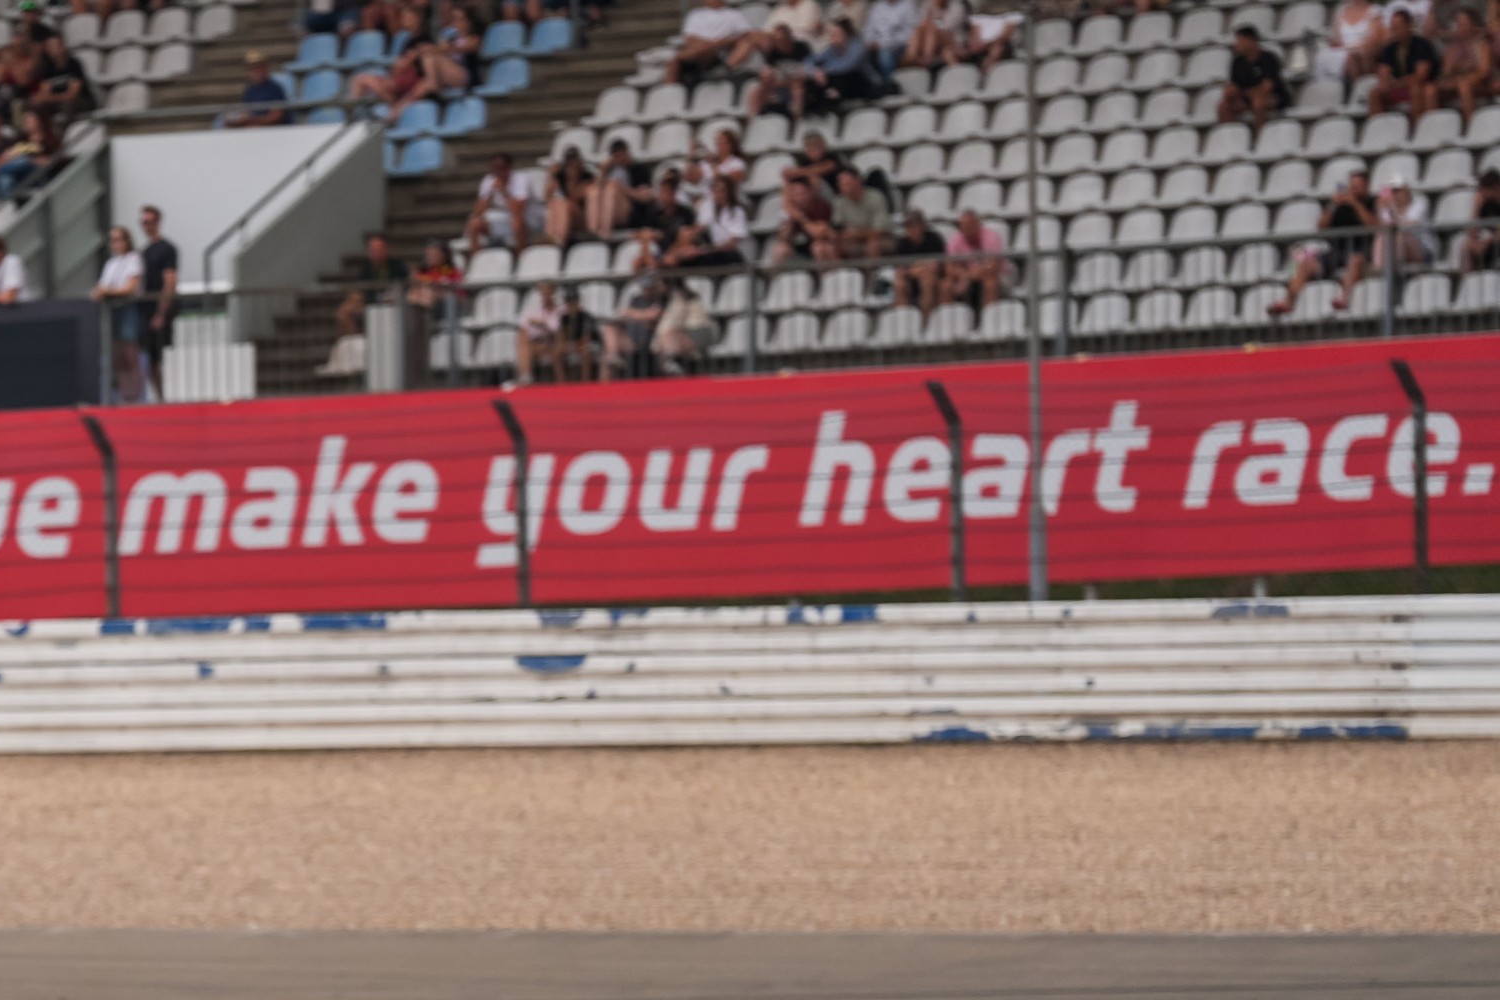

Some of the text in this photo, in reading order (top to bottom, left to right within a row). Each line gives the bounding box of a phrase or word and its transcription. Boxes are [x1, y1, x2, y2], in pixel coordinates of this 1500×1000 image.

[121, 434, 439, 557] make
[476, 444, 769, 567] your
[797, 401, 1150, 526] heart
[1183, 409, 1496, 510] race.
